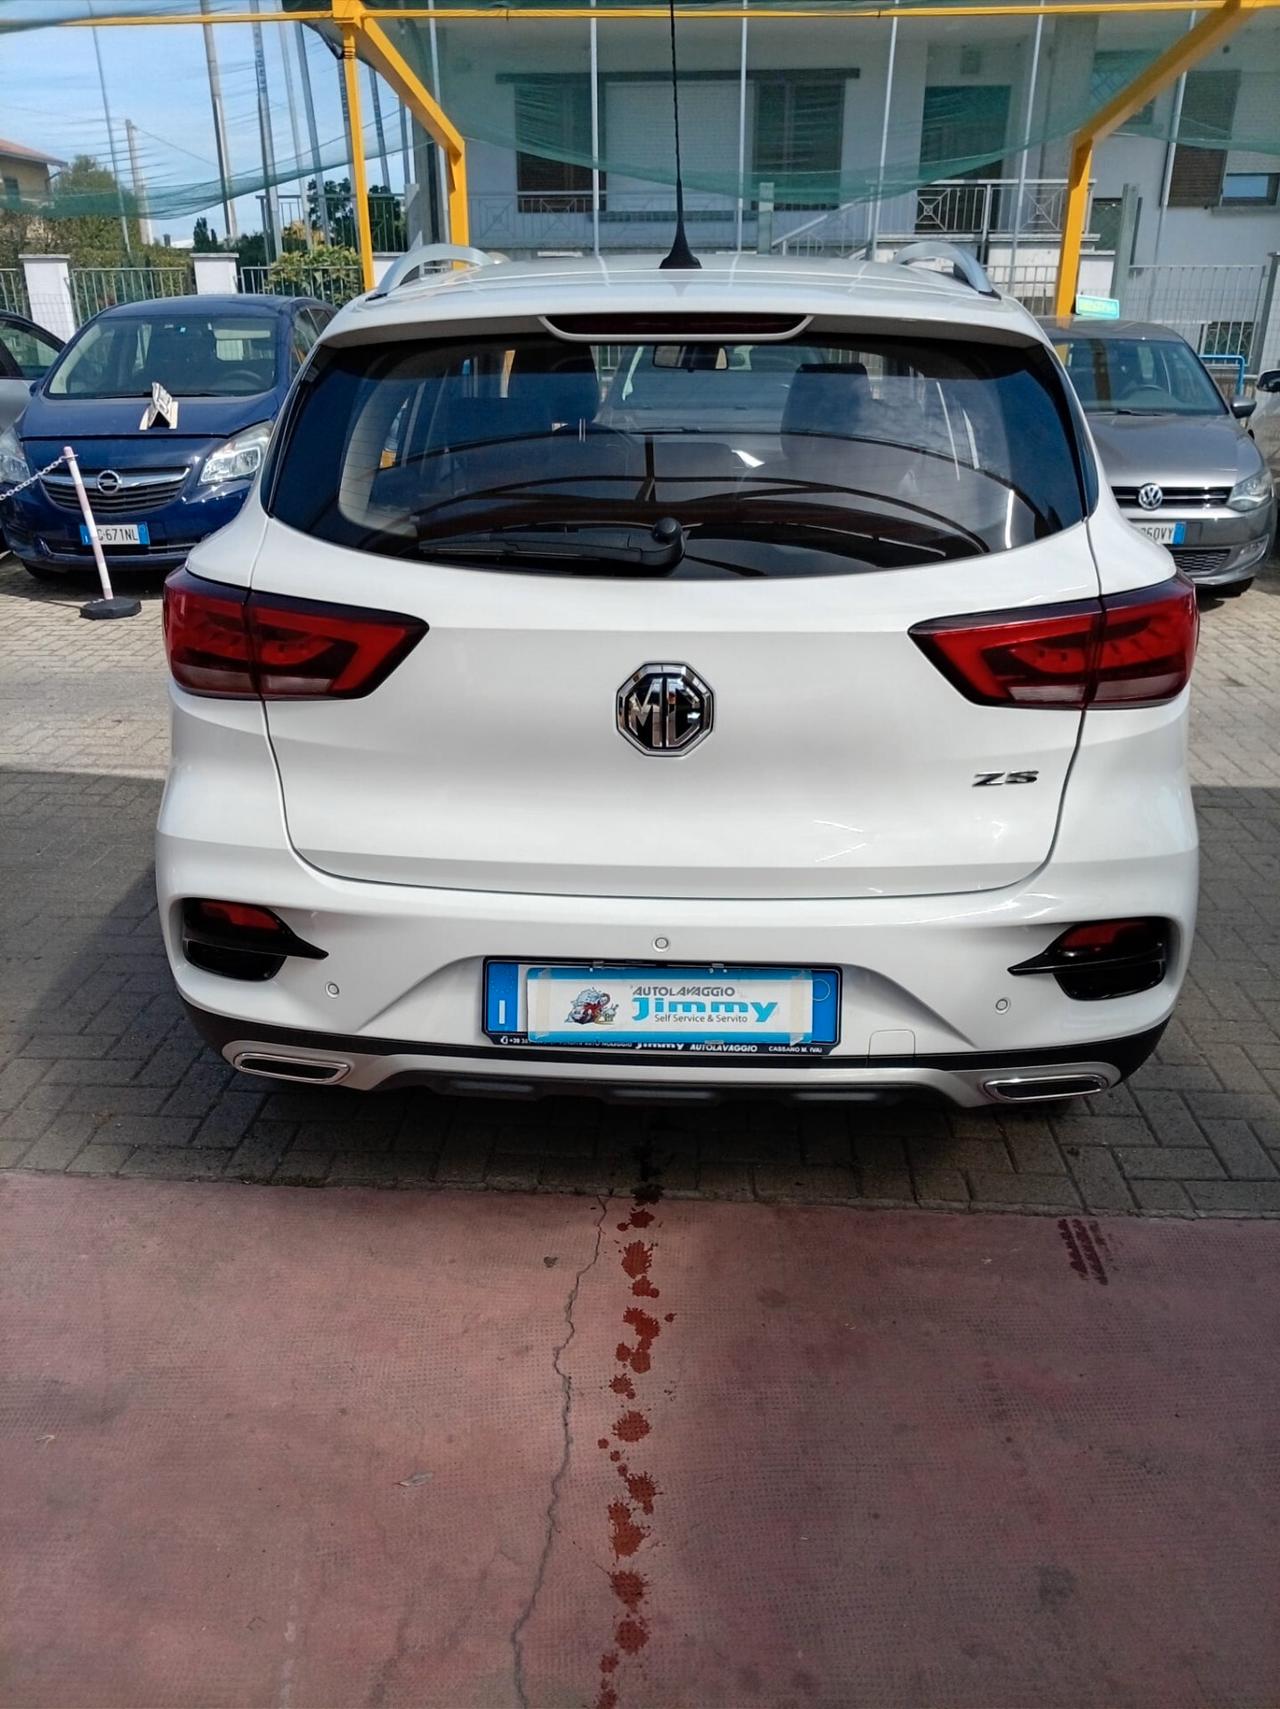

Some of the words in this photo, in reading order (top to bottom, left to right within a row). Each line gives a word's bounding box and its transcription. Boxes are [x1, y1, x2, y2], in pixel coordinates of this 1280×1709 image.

[628, 677, 702, 748] MG
[971, 770, 1039, 787] ZS
[632, 986, 736, 997] AUTOLAVAGGIO
[632, 997, 778, 1022] Jimmy
[655, 1014, 670, 1023] Self
[673, 1014, 704, 1023] Service
[708, 1014, 714, 1023] &
[716, 1014, 748, 1023] Servito
[690, 1043, 758, 1053] AUTOLAVAGGIO
